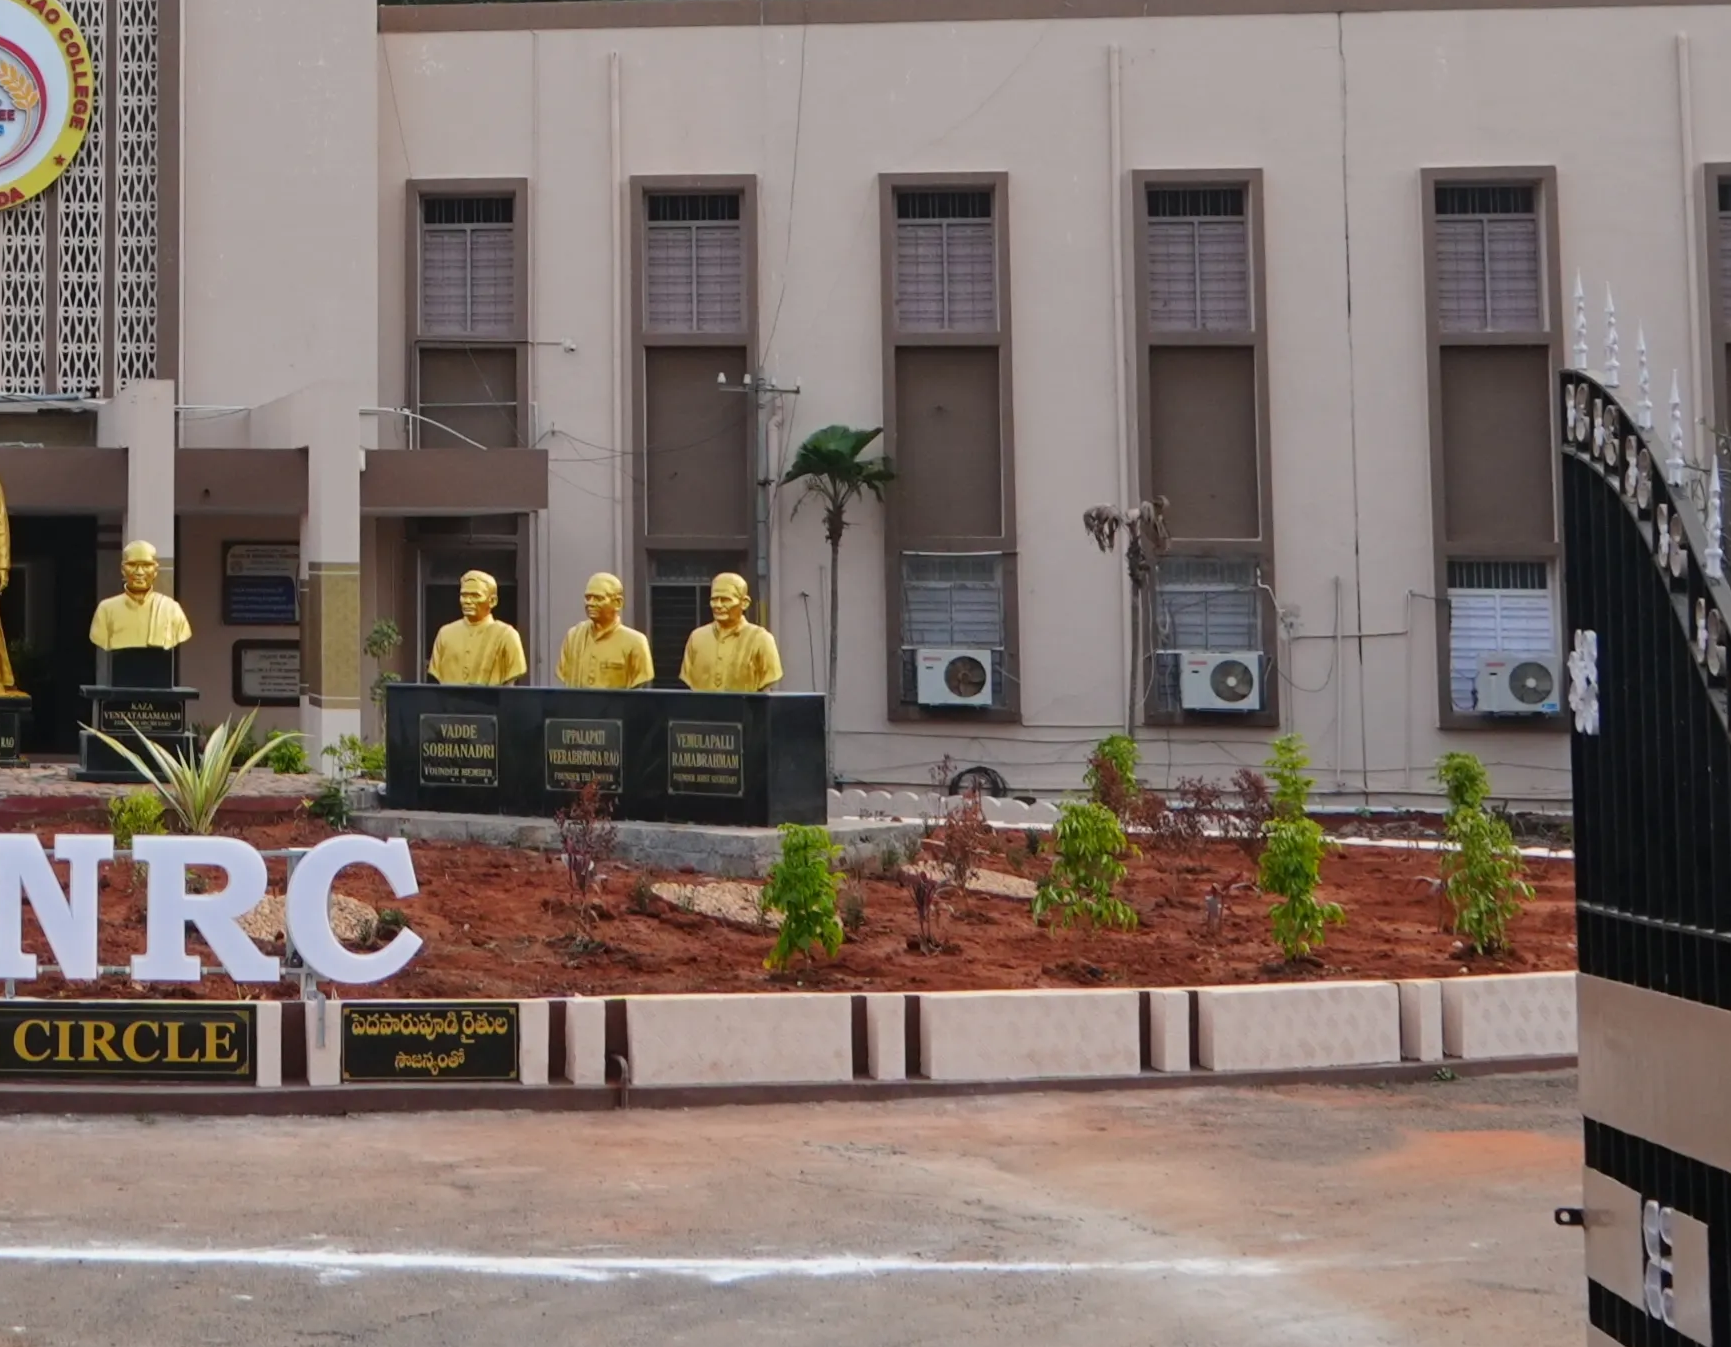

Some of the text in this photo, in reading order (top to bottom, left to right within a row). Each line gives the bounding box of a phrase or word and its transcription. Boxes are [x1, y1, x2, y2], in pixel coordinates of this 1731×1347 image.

[58, 26, 90, 131] COLLEGE
[440, 724, 478, 739] VADDE
[422, 742, 495, 759] SOBHANADRI
[12, 1018, 241, 1066] CIRCLE
[459, 1010, 508, 1044] రైతుల
